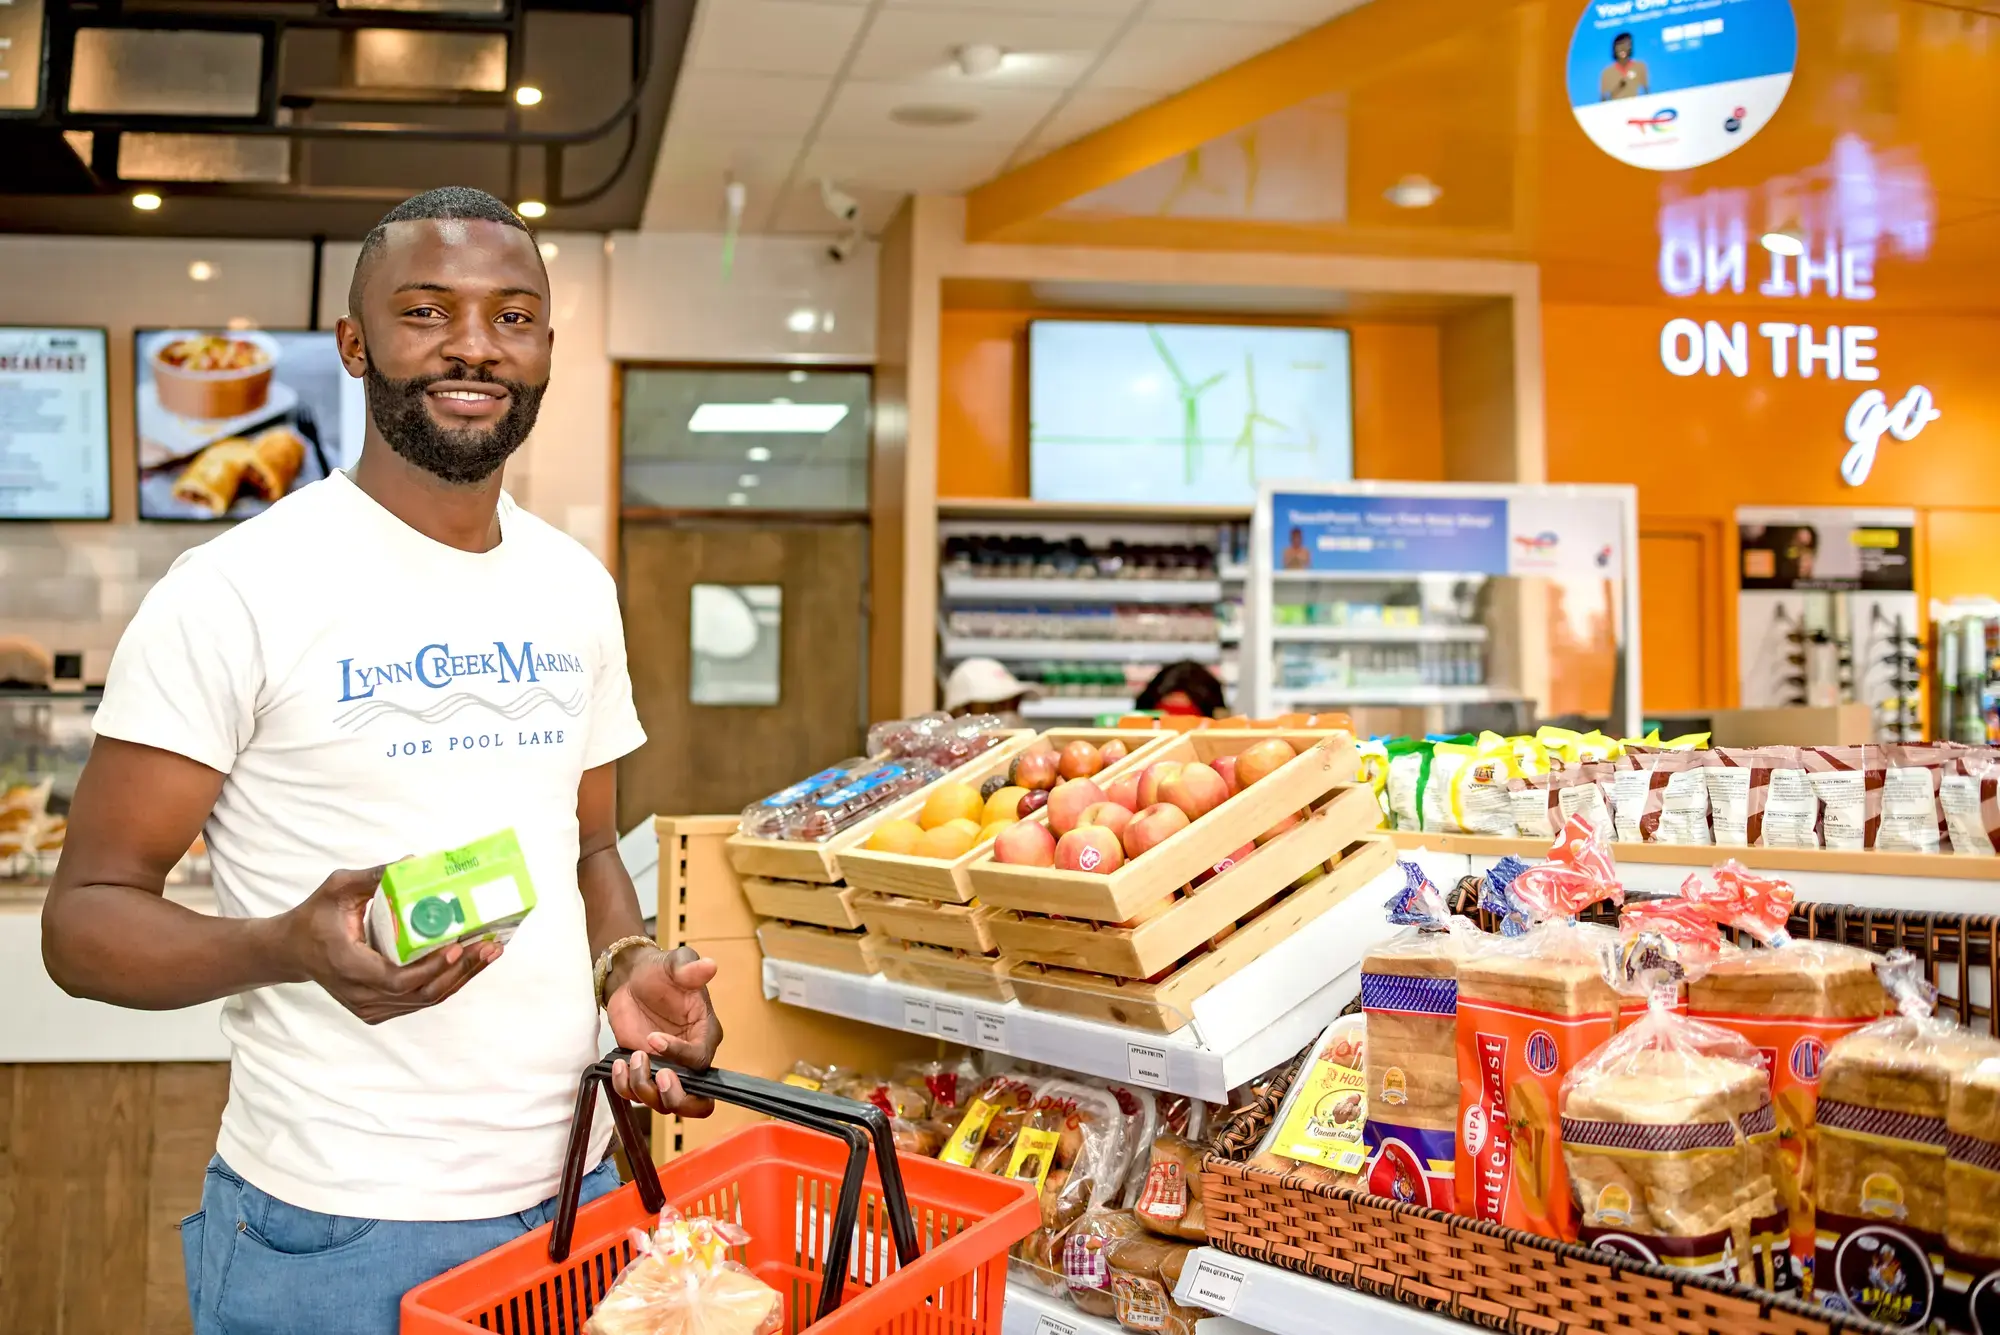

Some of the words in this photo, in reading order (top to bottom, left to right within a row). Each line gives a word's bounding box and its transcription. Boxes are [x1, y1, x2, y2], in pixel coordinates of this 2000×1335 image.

[1660, 318, 1748, 377] ON
[1758, 322, 1880, 381] THE
[1841, 385, 1941, 486] go
[386, 740, 433, 758] JOE
[449, 733, 504, 751] POOL
[518, 730, 565, 745] LAKE
[1486, 1041, 1507, 1124] Toast
[1313, 1126, 1336, 1139] Queen
[1337, 1129, 1358, 1141] Cake
[1468, 1109, 1481, 1152] SUPA
